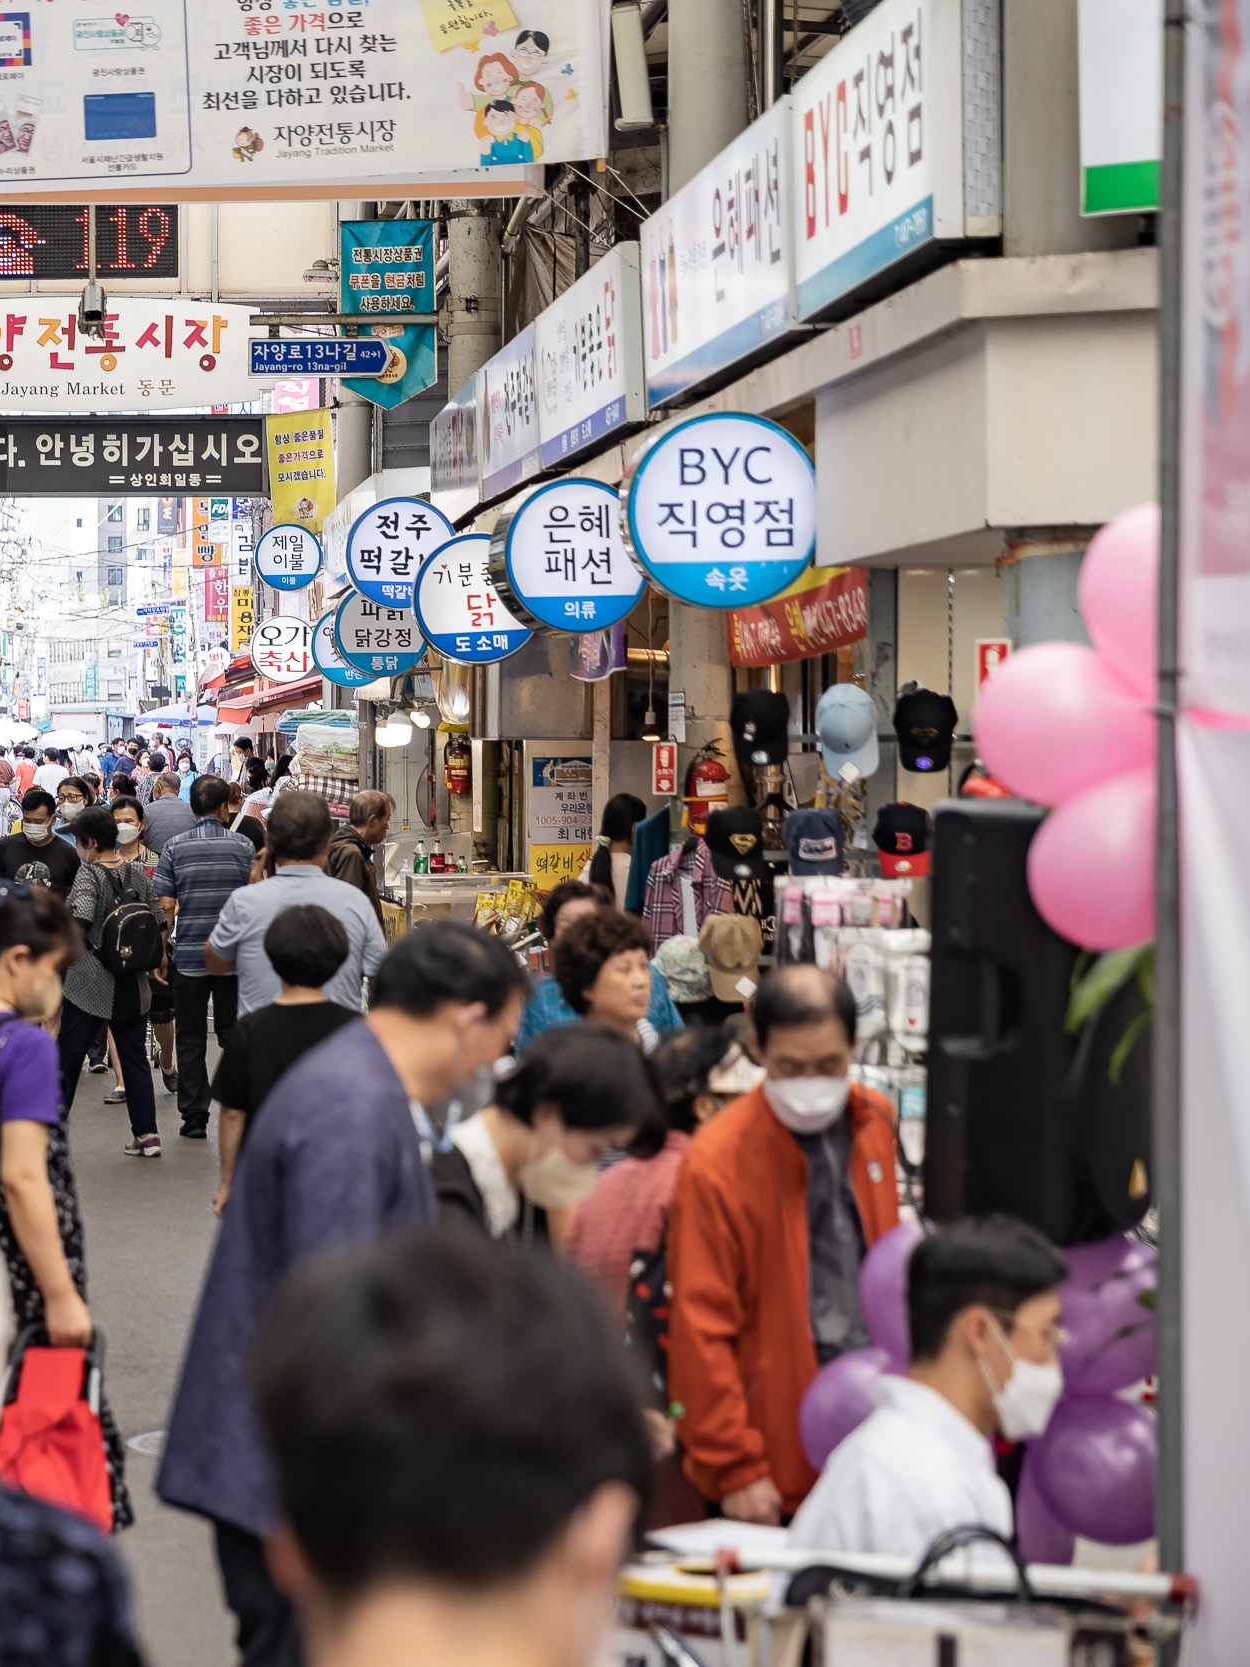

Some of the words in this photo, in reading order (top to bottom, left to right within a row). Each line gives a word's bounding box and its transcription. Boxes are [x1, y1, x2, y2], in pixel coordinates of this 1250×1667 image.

[244, 15, 282, 36] 좋은
[288, 11, 365, 33] 가격으로
[213, 38, 308, 61] 고객님께서
[315, 35, 352, 56] 다시
[359, 34, 397, 53] 찾는
[246, 63, 302, 84] 시장이
[309, 60, 366, 80] 되도록
[202, 89, 259, 111] 최선을
[265, 88, 323, 108] 다하고
[329, 81, 411, 105] 있습니다.
[853, 7, 923, 197] 직영점
[272, 119, 397, 148] 자양전통시장
[274, 148, 312, 160] Jayang
[314, 146, 359, 157] Tradition
[360, 142, 395, 154] Market
[803, 78, 849, 241] BYC
[75, 208, 170, 269] 119
[352, 245, 423, 264] 전통시장상품권
[349, 273, 381, 290] 쿠폰을
[384, 271, 425, 289] 현금처럼
[359, 294, 415, 311] 사용하세요.
[253, 344, 357, 361] 자양로13나길
[253, 361, 303, 373] Jayang-ro
[307, 361, 347, 372] 13na-gil
[0, 381, 60, 397] Jayang
[66, 381, 126, 395] Market
[136, 379, 176, 397] 동문
[273, 433, 290, 446] 항상
[293, 428, 325, 443] 좋은품질
[36, 432, 263, 467] 안녕히가십시오
[277, 449, 325, 464] 좋은가격으로
[276, 467, 327, 483] 모시겠습니다.
[678, 446, 773, 487] BYC
[129, 472, 202, 488] 상인회일동
[376, 511, 432, 541] 전주
[543, 503, 611, 544] 은혜
[657, 497, 795, 549] 직영점
[272, 535, 304, 553] 제일
[273, 554, 305, 571] 이불
[359, 546, 425, 576] 떡갈
[545, 547, 613, 585] 패션
[281, 576, 297, 585] 이불
[704, 566, 749, 592] 속옷
[466, 593, 497, 627] 닭
[563, 600, 597, 620] 의류
[258, 626, 311, 648] 오가
[355, 627, 412, 648] 닭강정
[455, 634, 473, 652] 도
[476, 632, 509, 650] 소매
[258, 651, 311, 673] 축산
[370, 655, 399, 671] 통닭
[554, 791, 592, 801] 계좌번
[557, 828, 569, 840] 최
[895, 832, 913, 851] B
[536, 851, 574, 873] 떡갈비
